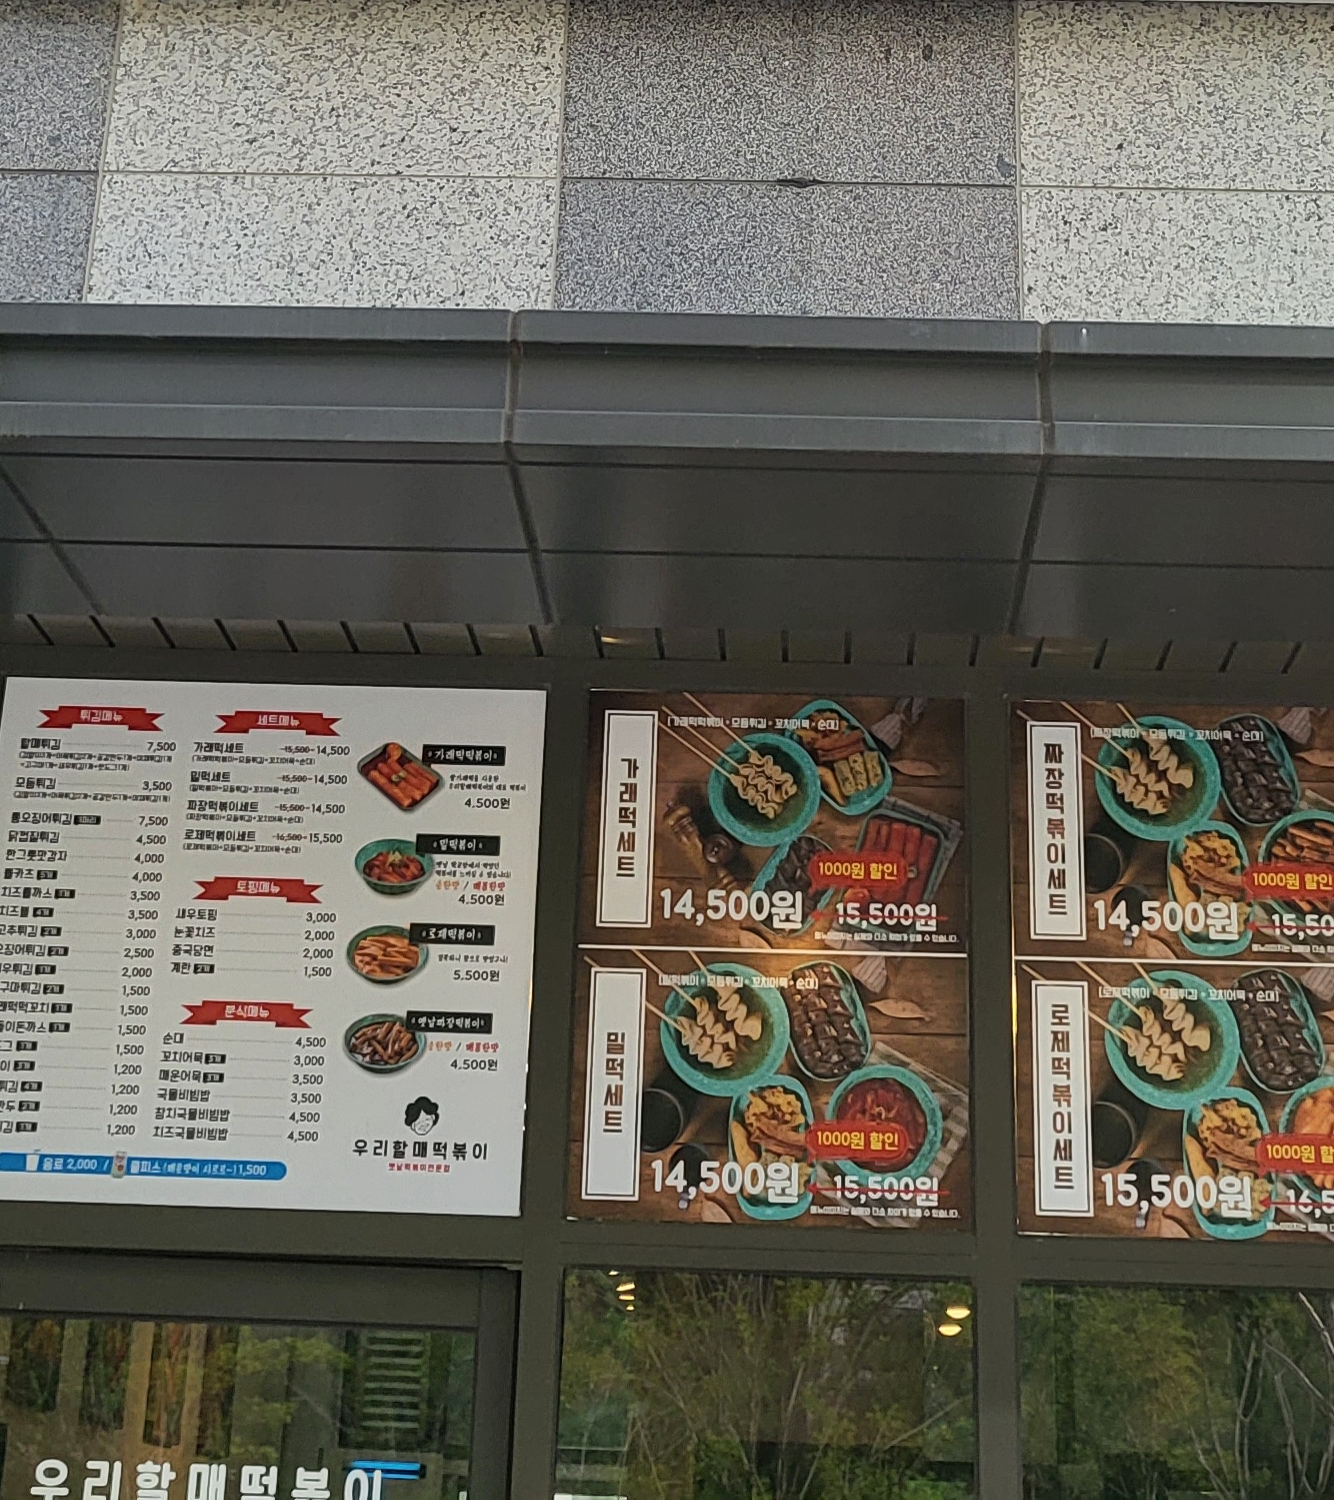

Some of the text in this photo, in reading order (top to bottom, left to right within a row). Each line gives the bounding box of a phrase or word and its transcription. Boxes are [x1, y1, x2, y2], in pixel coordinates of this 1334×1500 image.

[147, 742, 176, 753] 7,500
[194, 742, 244, 754] 가래떡세트
[317, 745, 350, 757] 14,500
[435, 748, 493, 762] 가래떡떡볶이
[142, 781, 172, 792] 3,500
[314, 775, 347, 786] 14,500
[312, 803, 345, 815] 14,500
[465, 798, 510, 810] 4.500원
[138, 816, 168, 827] 7,500
[616, 758, 639, 878] 가래떡세트
[1043, 742, 1067, 916] 짜장떡볶이세트
[135, 834, 166, 846] 4,500
[183, 829, 256, 842] 로제떡볶이세트
[309, 833, 343, 844] 15,500
[134, 853, 164, 864] 4,000
[132, 872, 162, 883] 4,000
[818, 861, 898, 881] 1000원 할인
[1252, 872, 1333, 891] 1000원 할인
[130, 891, 160, 902] 3,500
[459, 894, 505, 906] 4.500원
[128, 910, 158, 921] 3,500
[176, 908, 336, 924] 새우토핑 3,000
[660, 888, 803, 930] 14,500원
[835, 902, 937, 932] 15,500원
[1094, 900, 1241, 941] 14,500원
[126, 929, 156, 940] 3,000
[174, 926, 335, 942] 눈꽃치즈 2,000
[428, 928, 475, 941] 로제떡볶이
[124, 948, 154, 959] 2,500
[172, 944, 334, 960] 중국당면 2,000
[122, 967, 152, 978] 2,000
[171, 962, 332, 978] 계란 1,500
[453, 969, 499, 982] 5.500원
[123, 985, 150, 997] 1,500
[120, 1005, 148, 1016] 1,500
[117, 1024, 146, 1036] 1,500
[163, 1033, 326, 1049] 순대 4,500
[115, 1044, 144, 1056] 1,500
[160, 1051, 324, 1068] 꼬치어묵 3,000
[451, 1058, 498, 1071] 4.500원
[114, 1064, 142, 1076] 1,200
[292, 1074, 323, 1086] 3,500
[602, 1031, 627, 1133] 밀떡세트
[111, 1084, 140, 1095] 1,200
[157, 1088, 322, 1105] 국물비빔밥 3,500
[1050, 1003, 1075, 1191] 로제떡볶이세트
[109, 1104, 137, 1116] 1,200
[155, 1107, 320, 1124] 참치국물비빔밥 4,500
[107, 1124, 135, 1136] 1,200
[153, 1126, 318, 1143] 치즈국물비빔밥 4,500
[816, 1130, 900, 1151] 1000원 할인
[353, 1139, 487, 1161] 우리할매떡볶이
[1266, 1143, 1315, 1163] 1000원
[42, 1158, 64, 1170] 음료
[66, 1158, 97, 1172] 2,000
[650, 1160, 800, 1203] 14,500원
[833, 1175, 940, 1207] 15,500원
[1101, 1173, 1252, 1218] 15,500원
